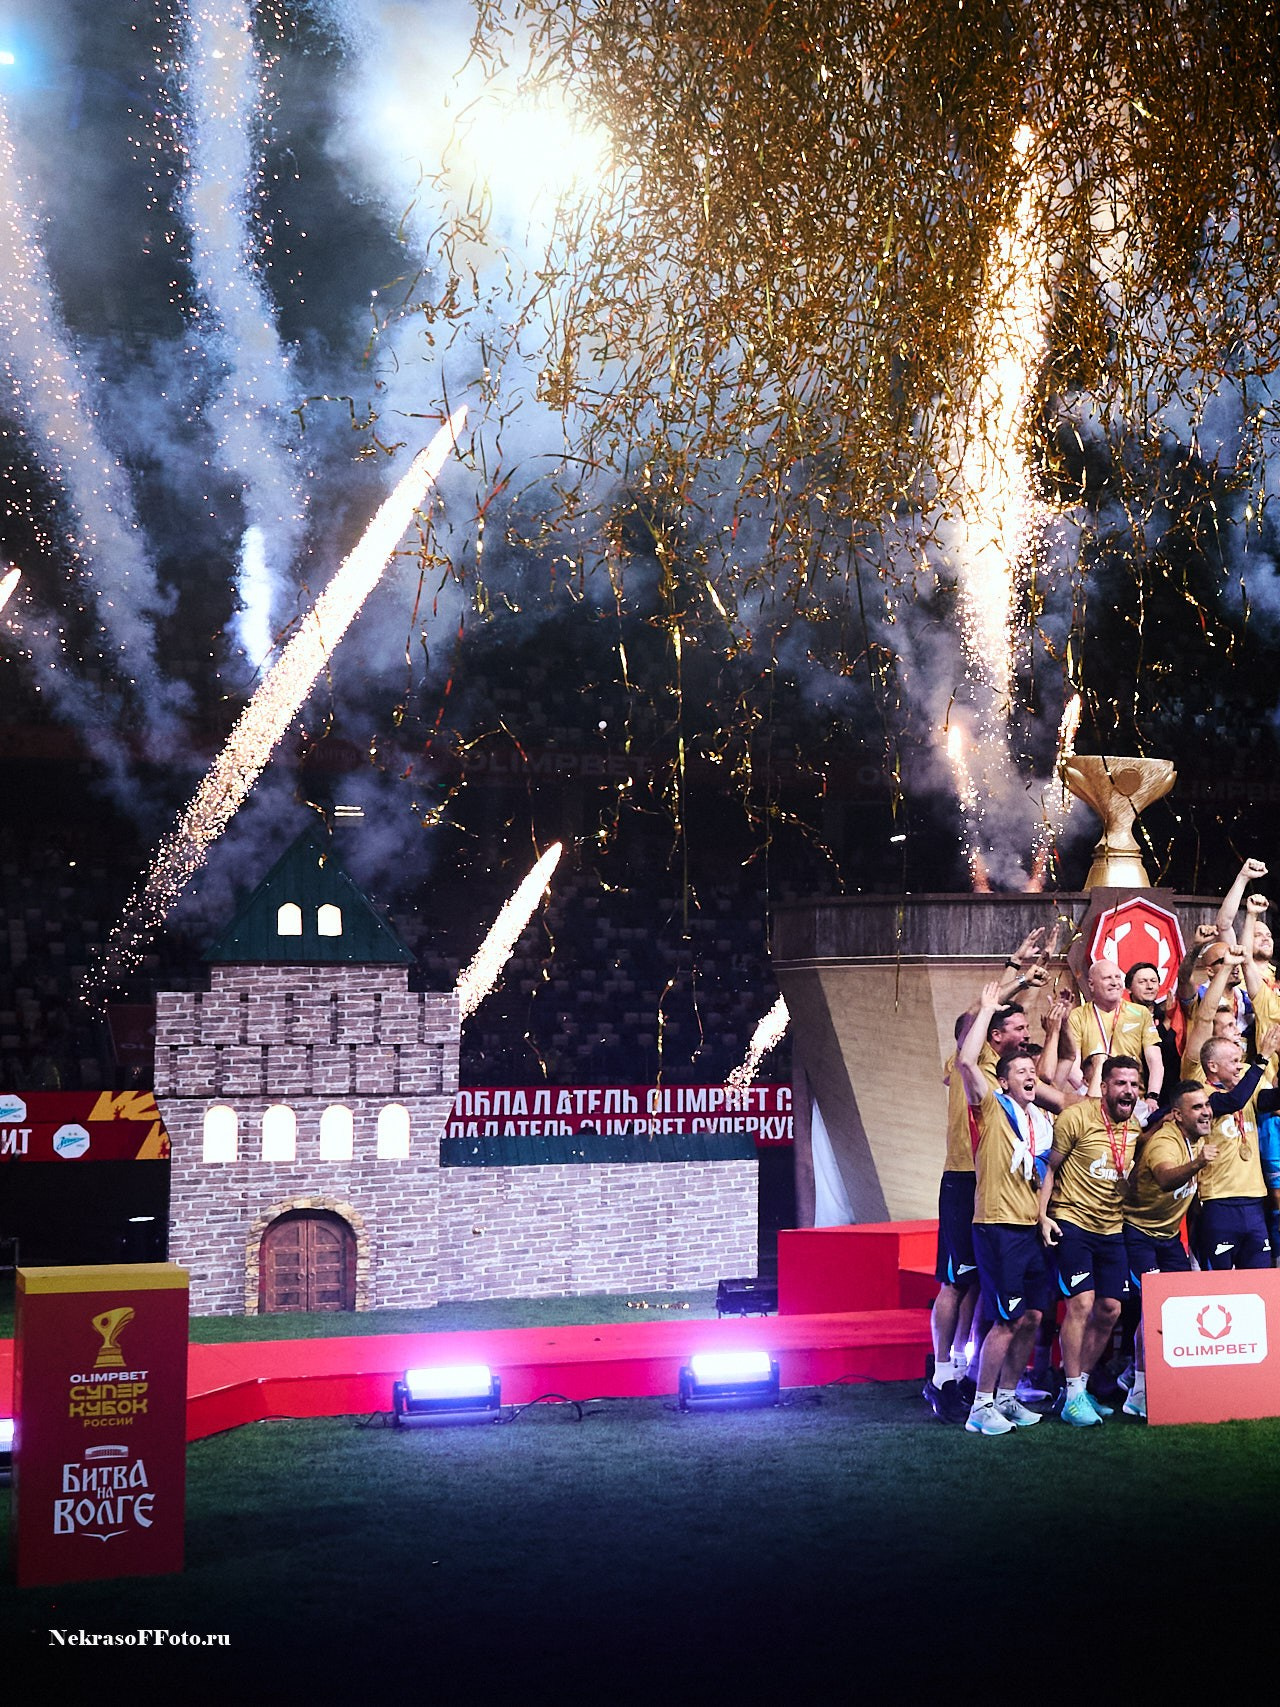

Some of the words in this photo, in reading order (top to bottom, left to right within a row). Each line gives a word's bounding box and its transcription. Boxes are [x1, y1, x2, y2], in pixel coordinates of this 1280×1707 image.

[1173, 1342, 1258, 1357] OLIMPBET
[69, 1370, 149, 1384] OLIMPBET
[68, 1382, 149, 1402] СУПЕР
[68, 1399, 149, 1418] КУБОК
[83, 1417, 133, 1428] РОССИИ
[62, 1459, 149, 1494] БИТВА
[97, 1485, 115, 1500] НА
[53, 1492, 156, 1536] ВОЛГЕ
